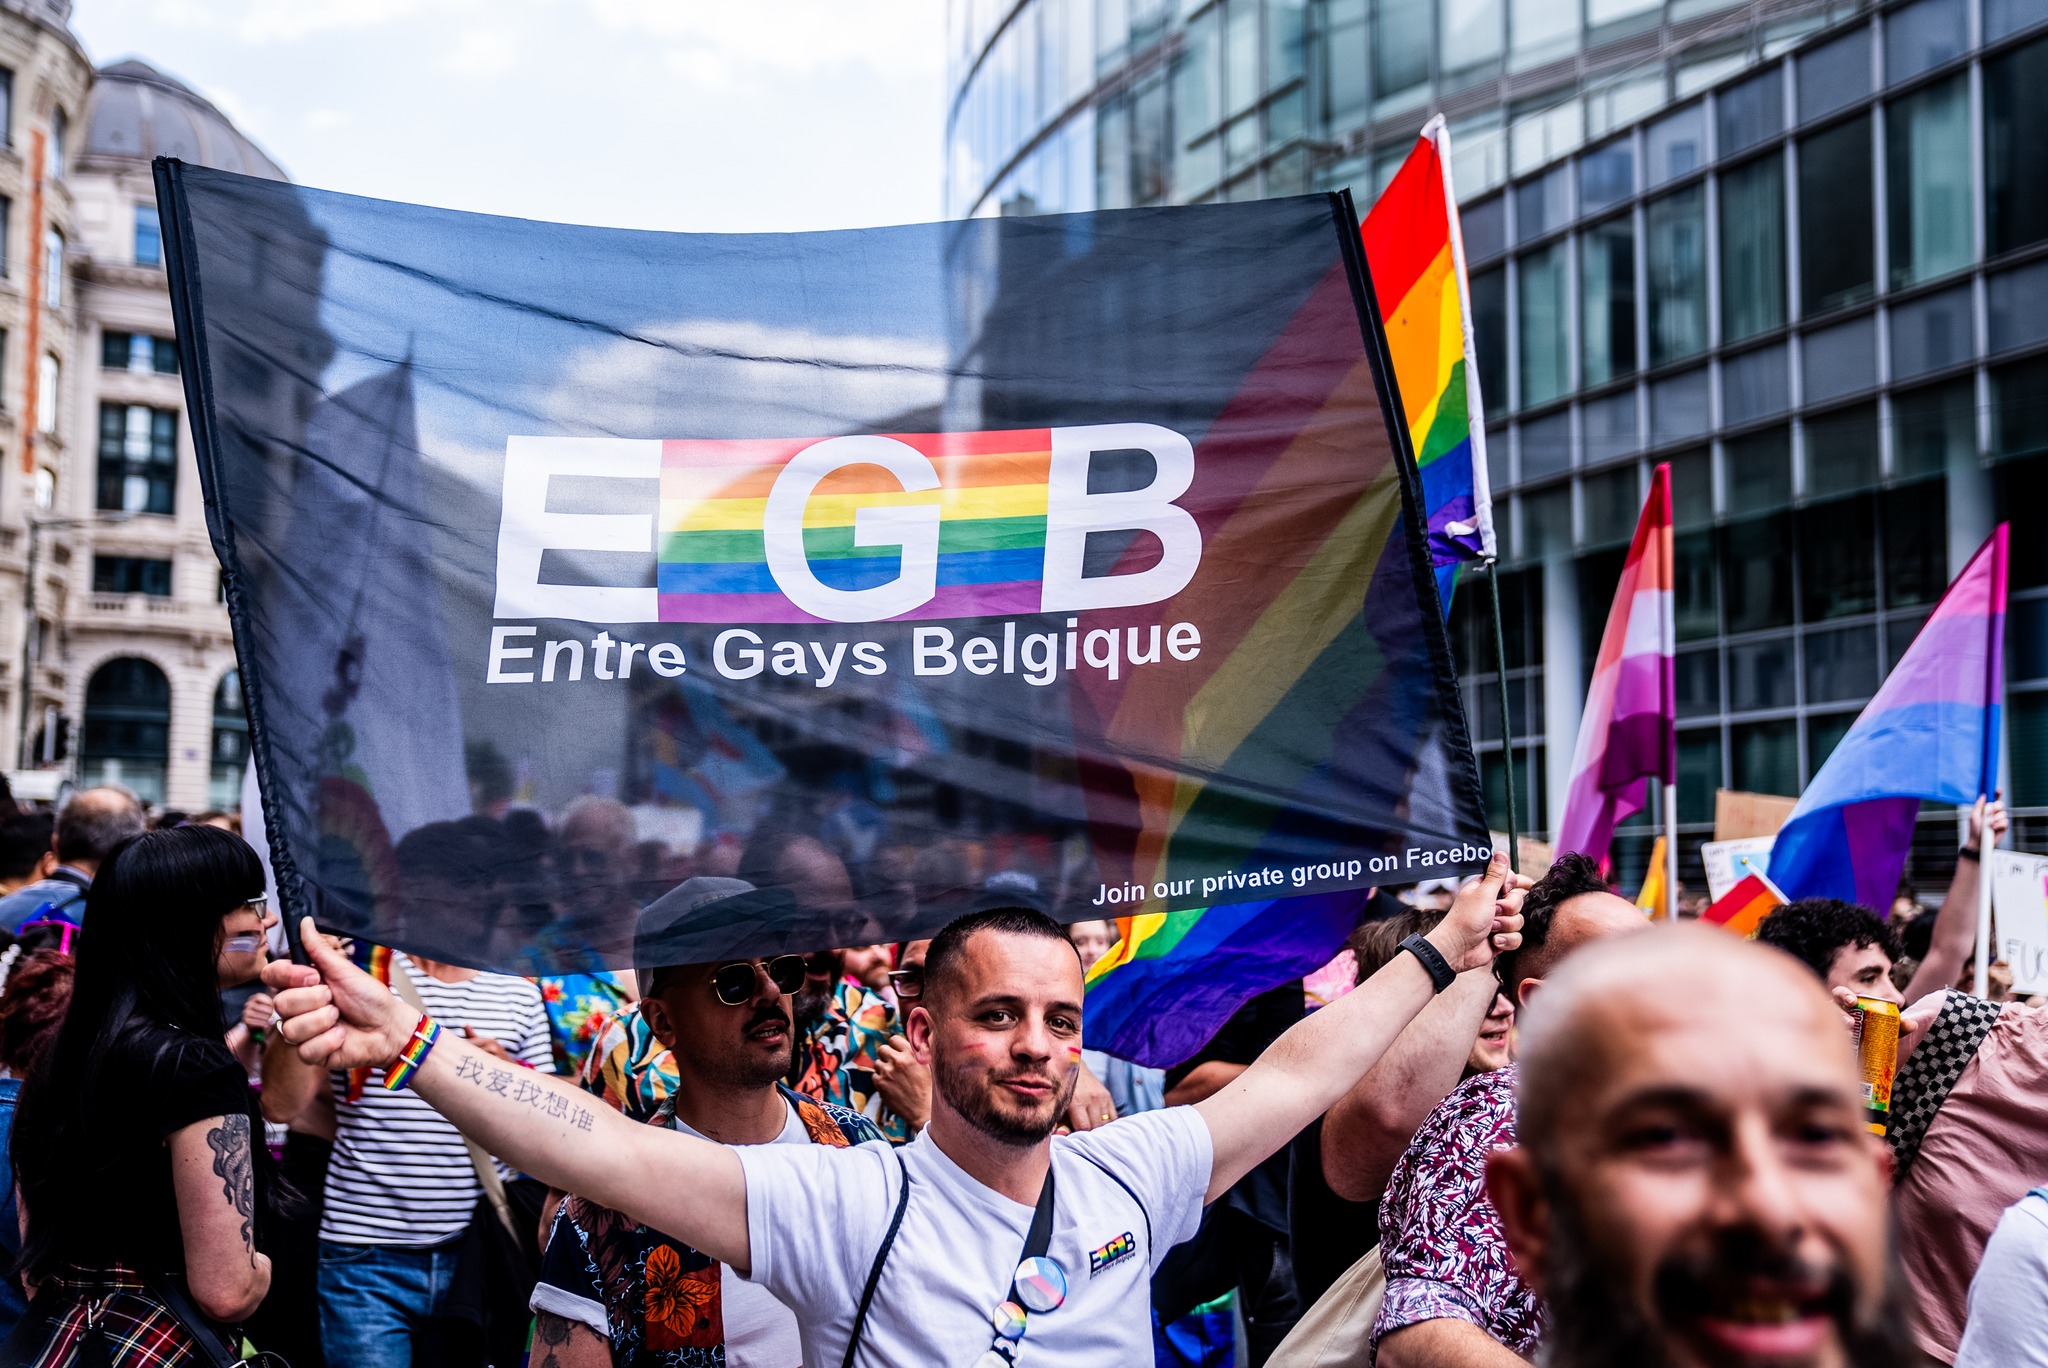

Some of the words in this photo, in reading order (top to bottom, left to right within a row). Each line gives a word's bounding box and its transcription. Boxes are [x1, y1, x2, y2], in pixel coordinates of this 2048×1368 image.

[492, 422, 1203, 623] EGB
[485, 626, 687, 684] Entre
[712, 628, 888, 688] Gays
[912, 618, 1202, 686] Belgique
[1092, 882, 1146, 906] Join
[1153, 878, 1196, 899] our
[1202, 866, 1284, 898] private
[1291, 860, 1362, 888] group
[1368, 855, 1399, 873] on
[1406, 843, 1494, 869] Facebo
[1089, 1231, 1136, 1275] EGB
